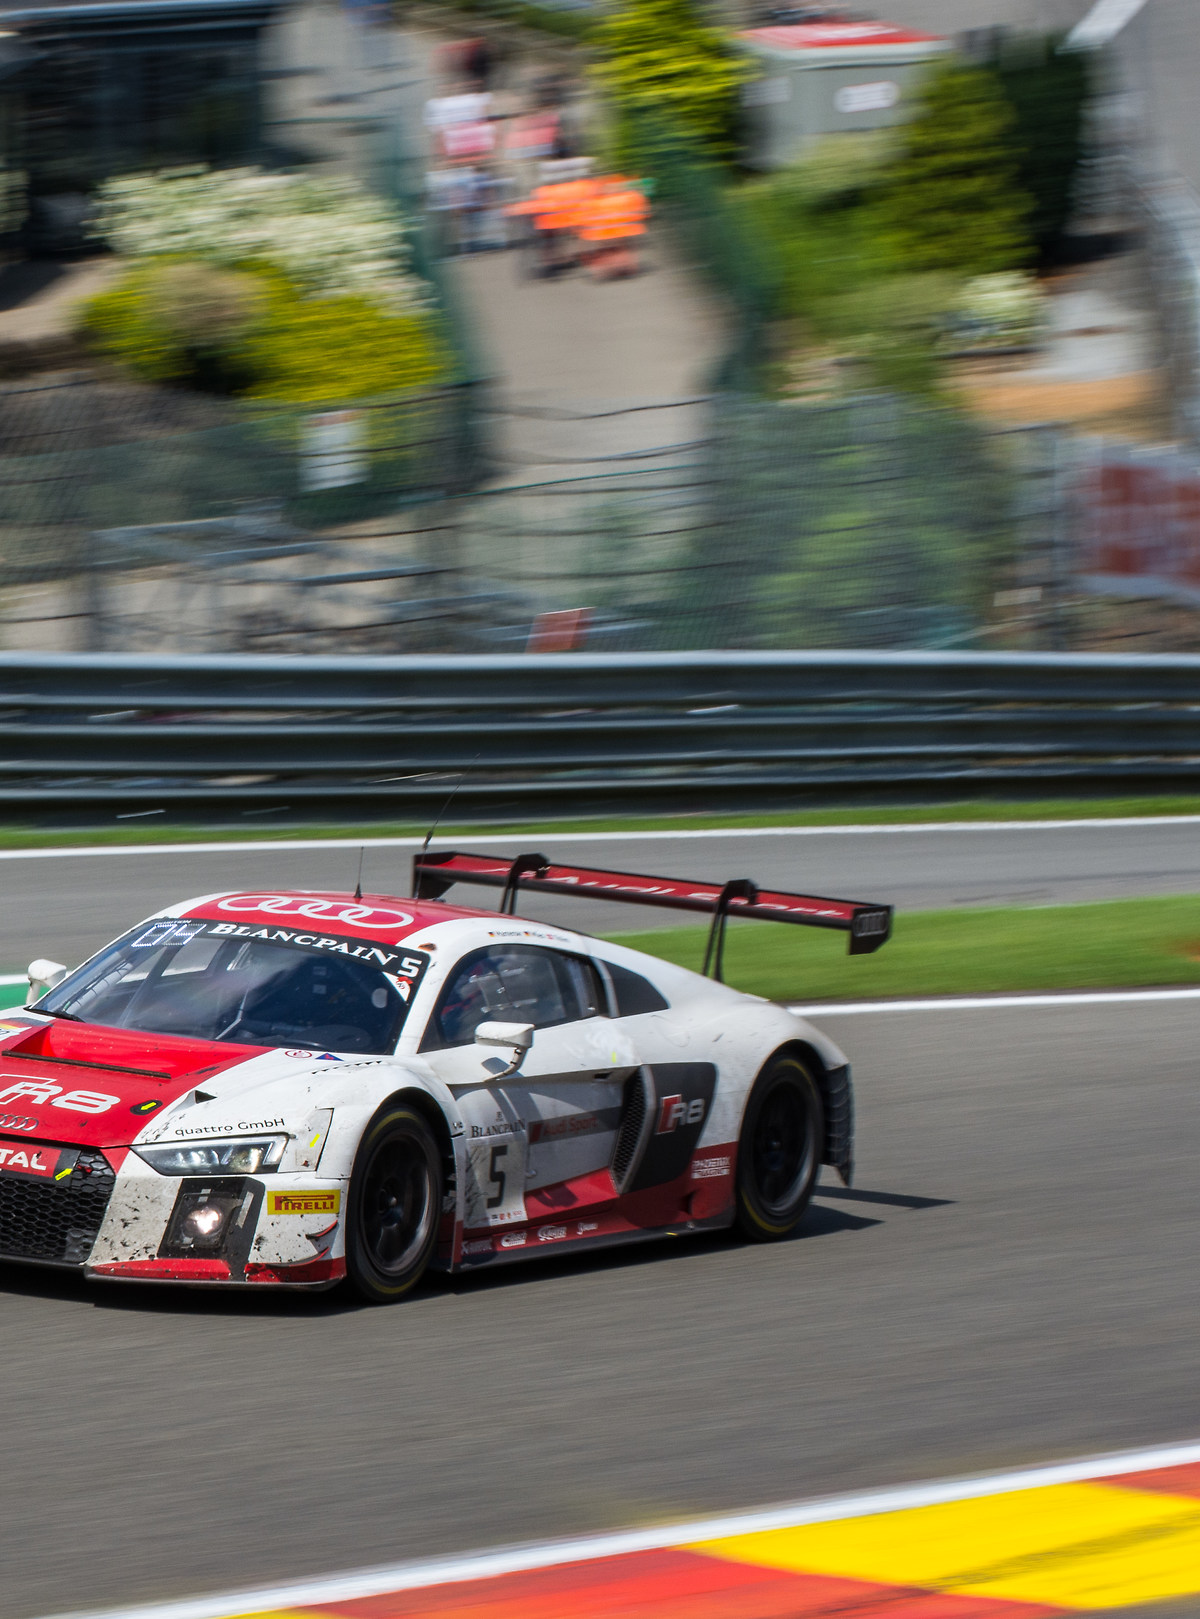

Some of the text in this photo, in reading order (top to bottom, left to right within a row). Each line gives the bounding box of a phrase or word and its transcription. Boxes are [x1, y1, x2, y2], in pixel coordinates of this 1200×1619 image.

[207, 923, 423, 978] BLANCPAIN 5
[175, 1117, 286, 1137] quattro GmbH
[471, 1118, 527, 1138] BLANCPAIN
[486, 1144, 509, 1209] 5
[274, 1194, 335, 1211] PIRELLI
